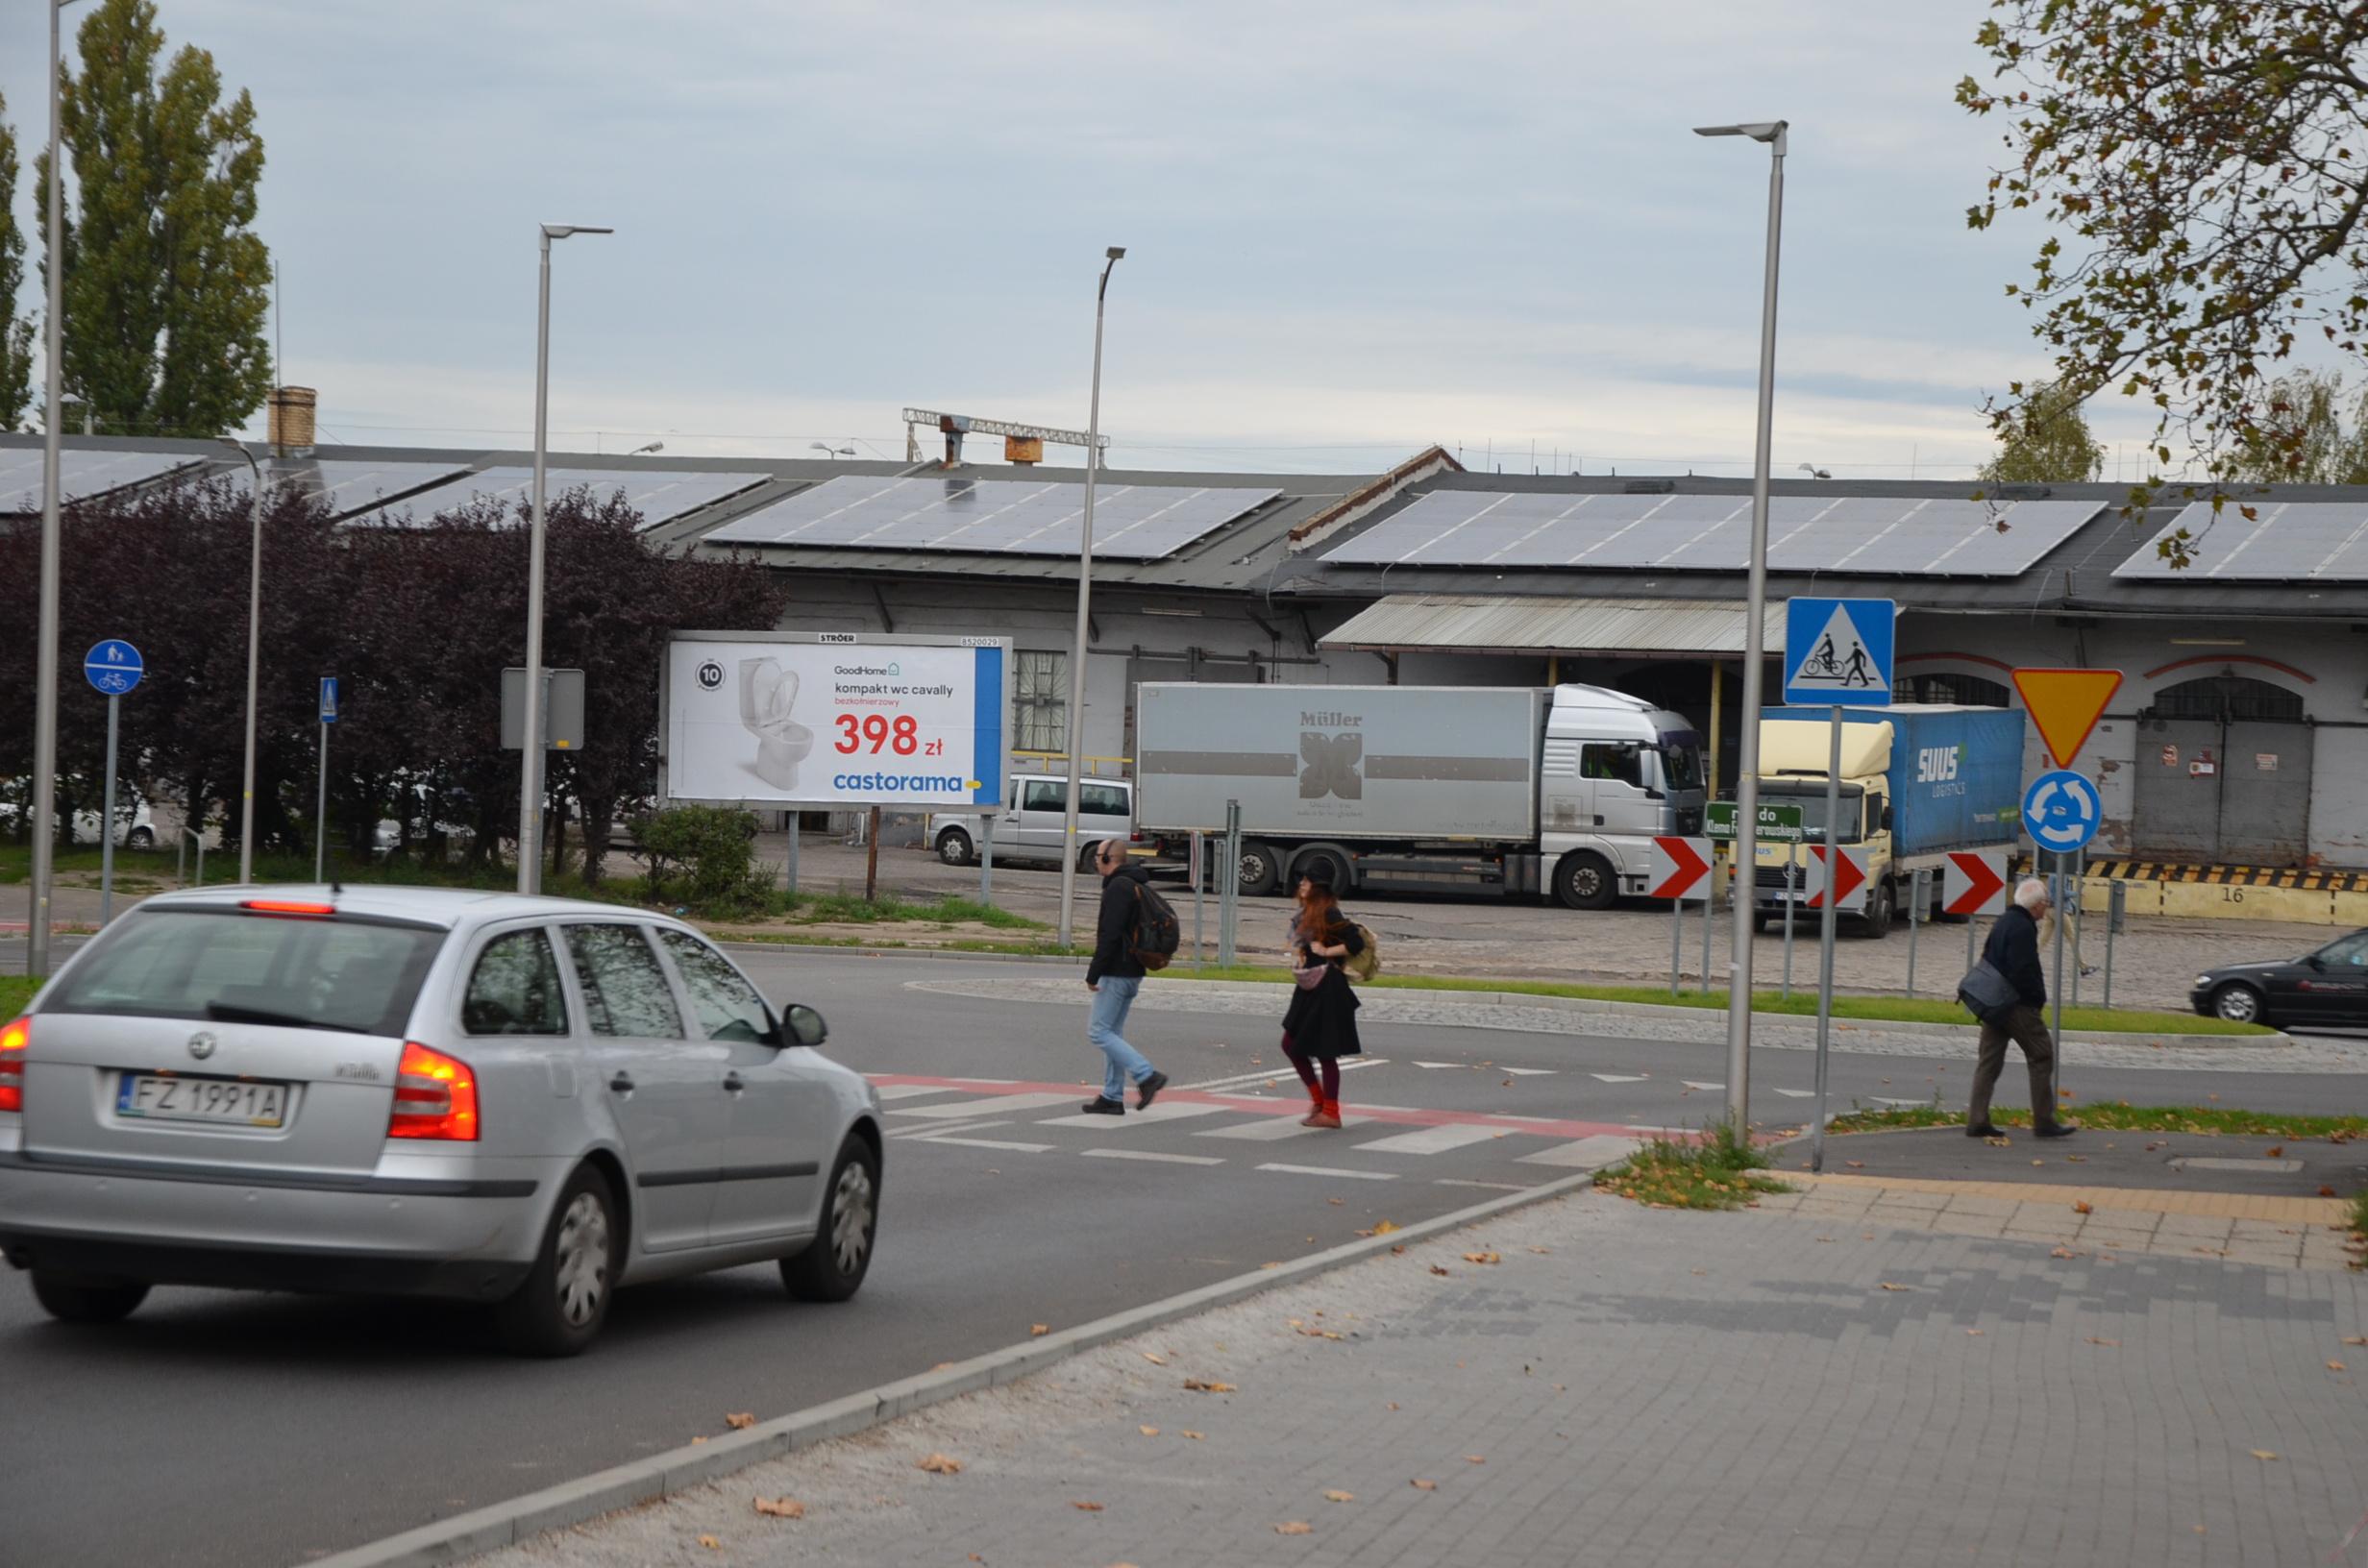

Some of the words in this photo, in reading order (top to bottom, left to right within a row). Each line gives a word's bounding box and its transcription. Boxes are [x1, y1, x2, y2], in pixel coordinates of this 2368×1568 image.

[820, 634, 855, 643] STRÖER
[702, 668, 720, 682] 10
[834, 666, 887, 675] GoodHome
[835, 682, 888, 697] kompakt
[891, 686, 909, 695] wc
[912, 684, 953, 698] cavally
[834, 698, 900, 707] bezkołnierzowy
[1299, 711, 1363, 726] Müller
[834, 714, 918, 756] 398
[925, 738, 943, 756] zł
[1917, 746, 1959, 783] SUUS
[833, 772, 962, 792] castorama
[1732, 807, 1777, 821] rdo
[2222, 887, 2244, 904] 16
[137, 1079, 180, 1110] FZ
[191, 1084, 278, 1116] 1991A
